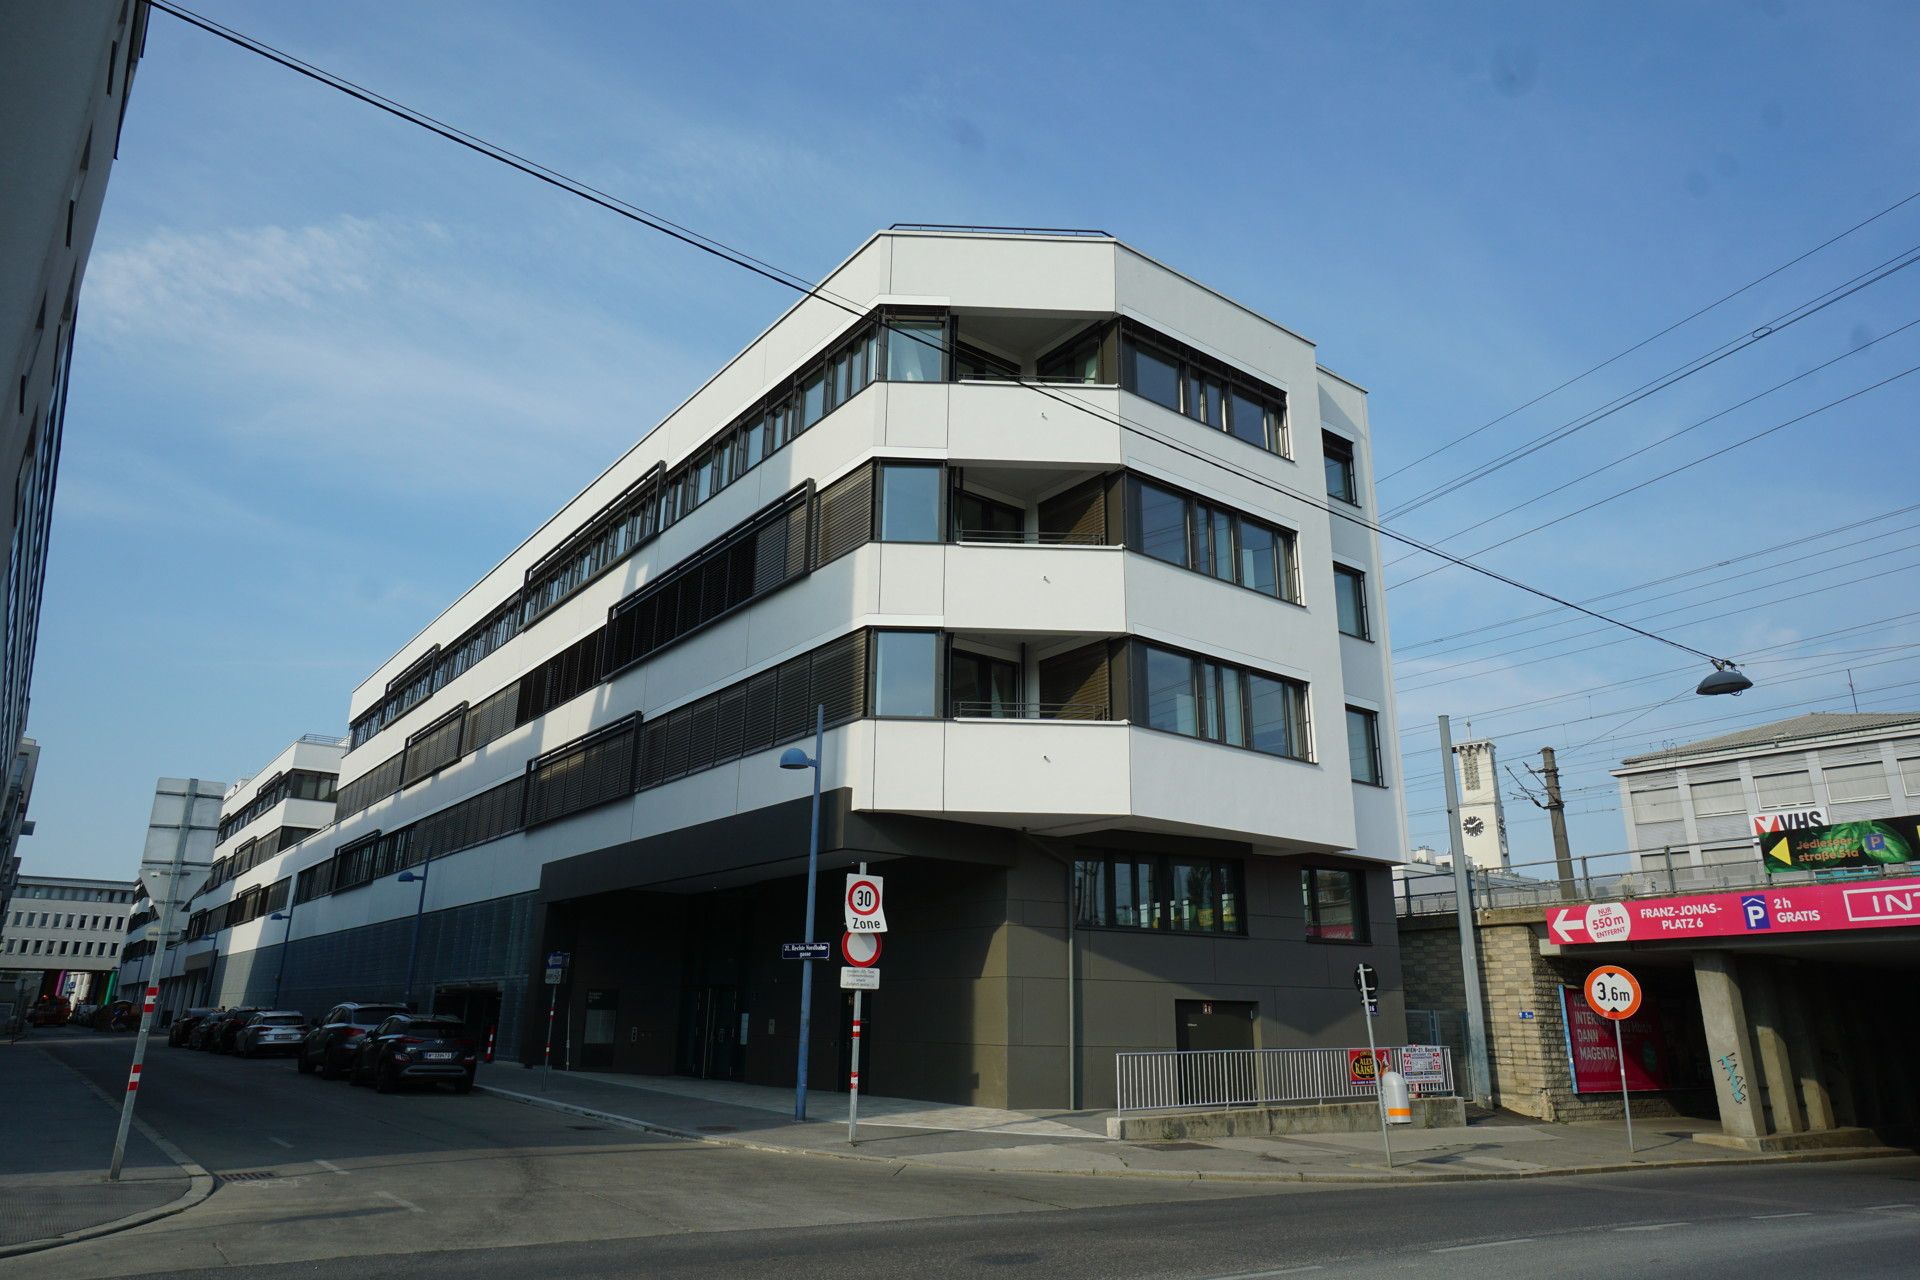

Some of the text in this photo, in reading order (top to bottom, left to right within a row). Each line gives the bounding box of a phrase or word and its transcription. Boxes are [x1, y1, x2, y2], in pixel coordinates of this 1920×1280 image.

[1779, 810, 1824, 830] VHS
[1871, 836, 1881, 848] P
[1798, 850, 1837, 862] straße
[856, 890, 872, 907] 30
[1773, 897, 1792, 910] 2 h
[1597, 906, 1612, 915] NUR
[1640, 903, 1723, 919] FRANZ-JONAS-
[1747, 906, 1765, 927] P
[1777, 909, 1821, 923] GRATIS
[852, 917, 881, 929] Zone
[1592, 915, 1625, 930] 550 m
[1661, 918, 1704, 930] PLATZ 6
[1596, 926, 1626, 939] ENTFERNT
[1596, 981, 1631, 1002] 3,6m
[1577, 1029, 1599, 1043] DANN
[1579, 1046, 1618, 1061] MAGENTA!
[1354, 1062, 1375, 1075] KAISE
